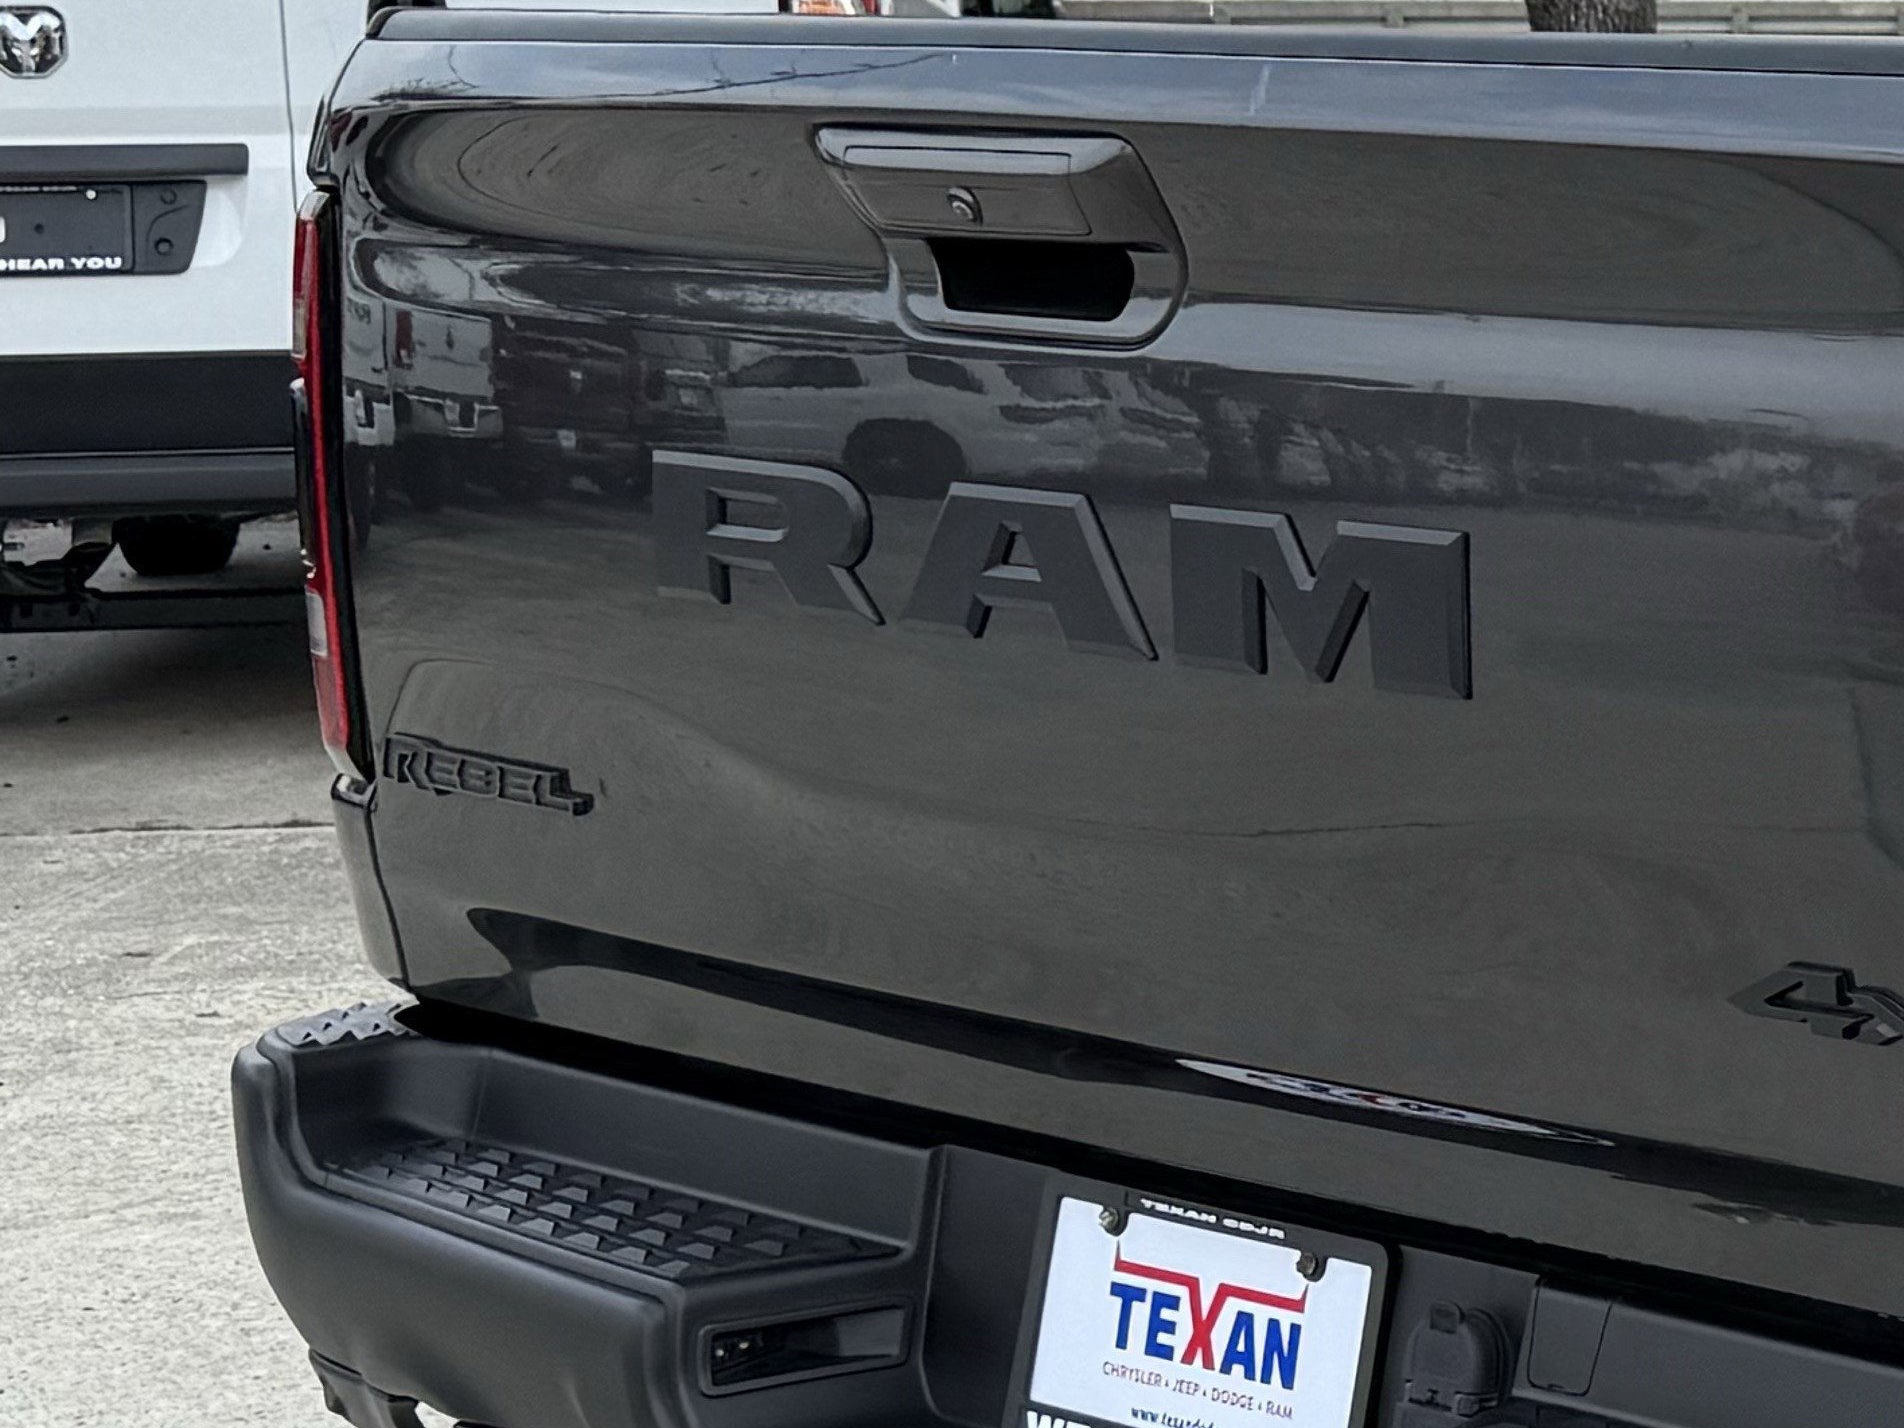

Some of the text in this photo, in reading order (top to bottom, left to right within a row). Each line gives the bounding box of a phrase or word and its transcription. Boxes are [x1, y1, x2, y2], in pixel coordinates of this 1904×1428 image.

[71, 256, 122, 270] YOU
[652, 449, 1473, 700] RAM
[382, 732, 594, 816] REBEL
[1140, 1197, 1217, 1224] TEXAN
[1110, 1240, 1308, 1391] TEXAN
